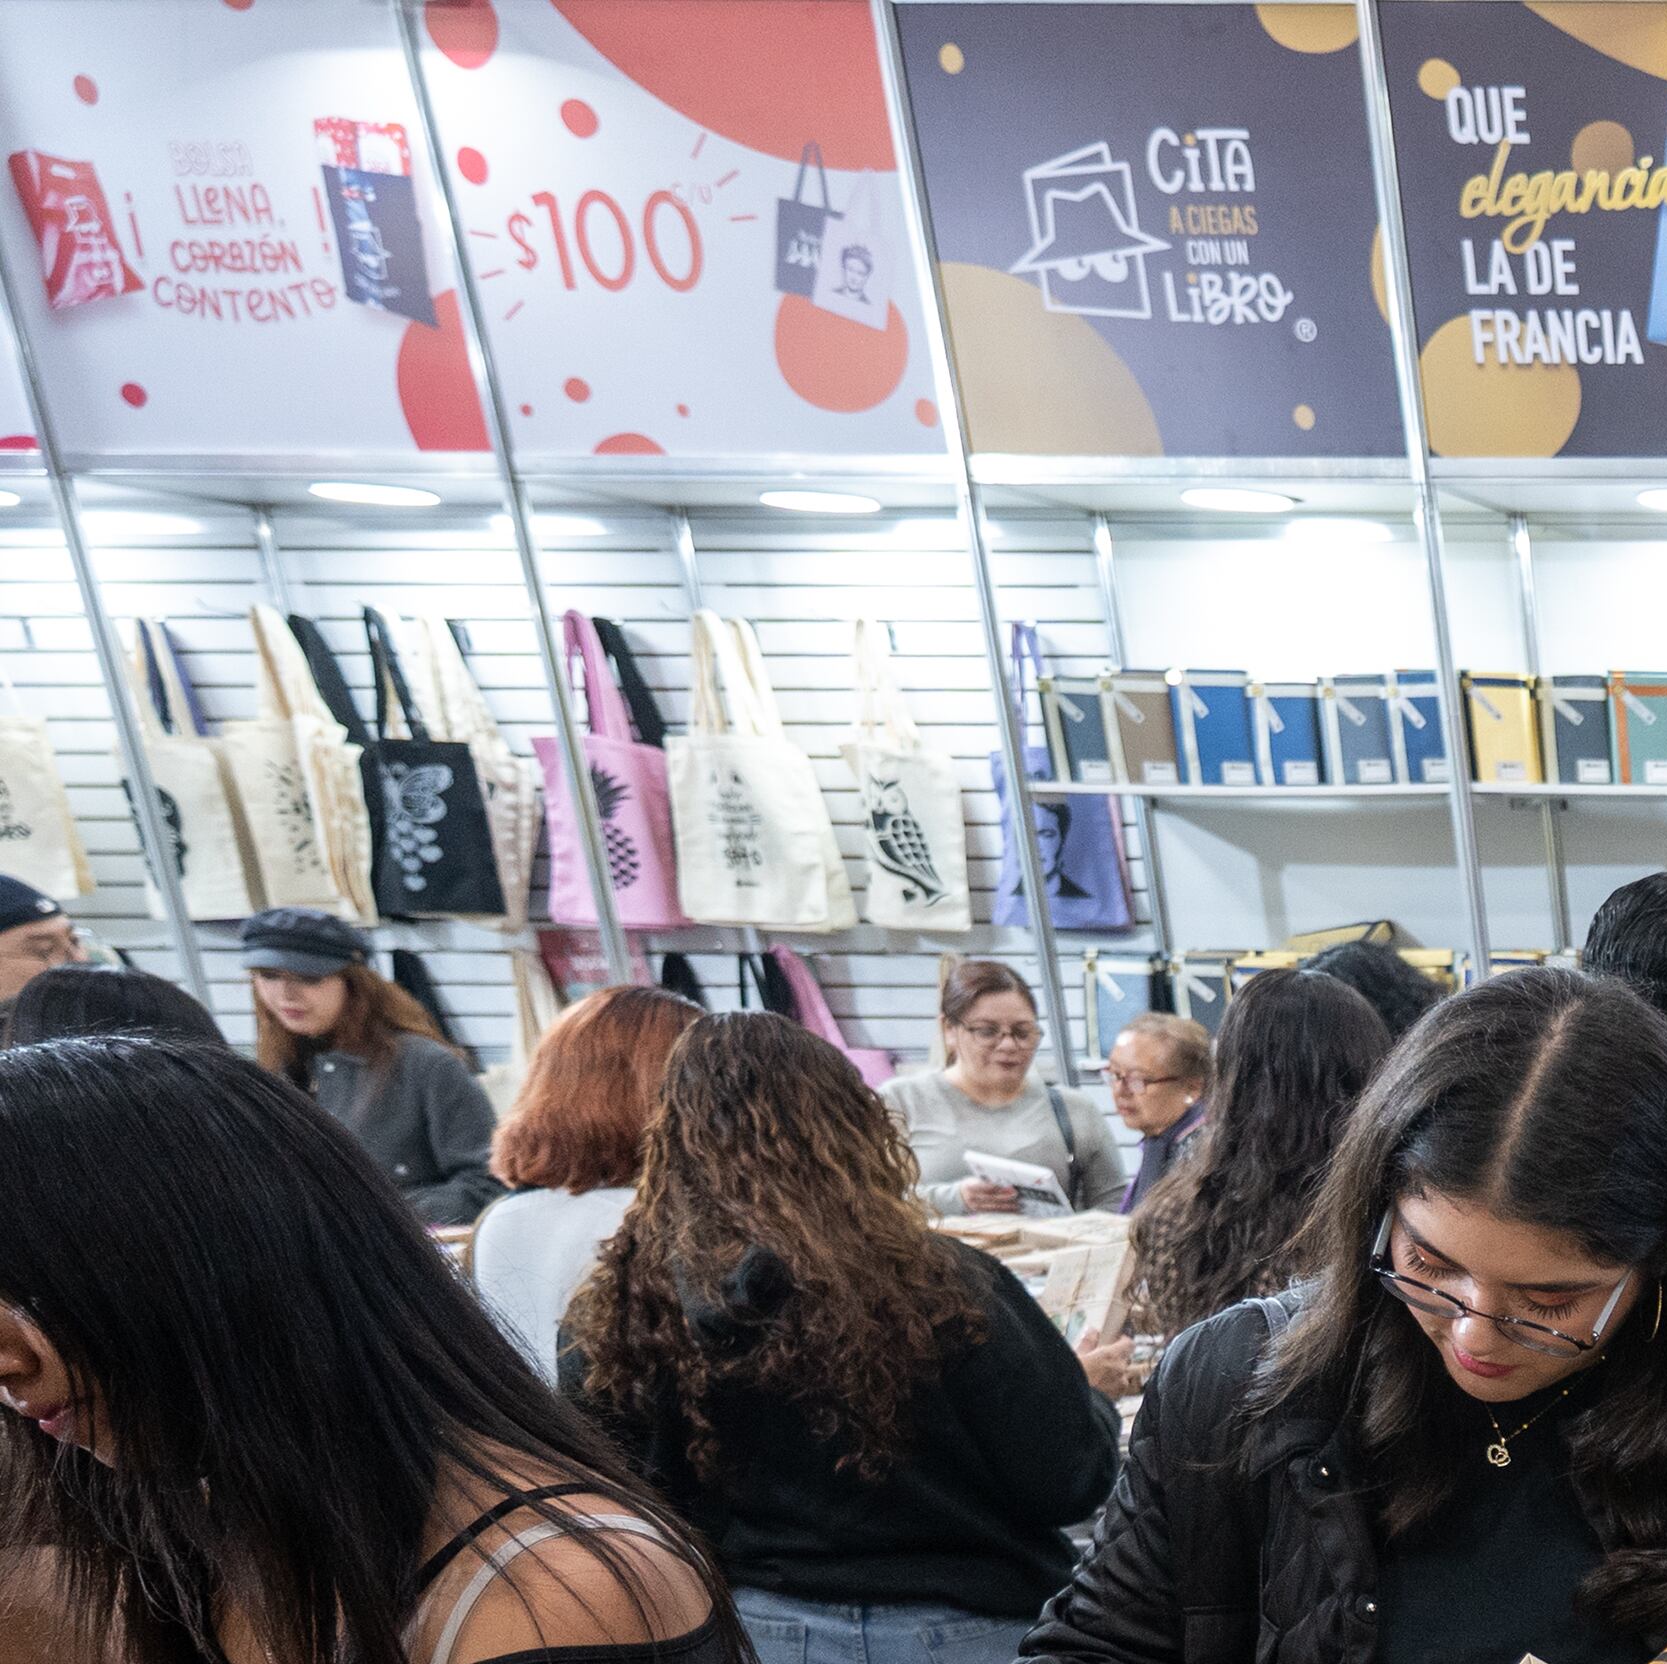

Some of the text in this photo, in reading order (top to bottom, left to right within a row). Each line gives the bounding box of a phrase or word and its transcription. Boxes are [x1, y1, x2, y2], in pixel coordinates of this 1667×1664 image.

[1446, 86, 1531, 146] QUE
[510, 188, 704, 292] $100
[1169, 206, 1259, 236] A CIEGAS
[1186, 240, 1250, 265] CON UN
[1462, 239, 1580, 296] LA DE
[1470, 309, 1645, 366] FRANCIA
